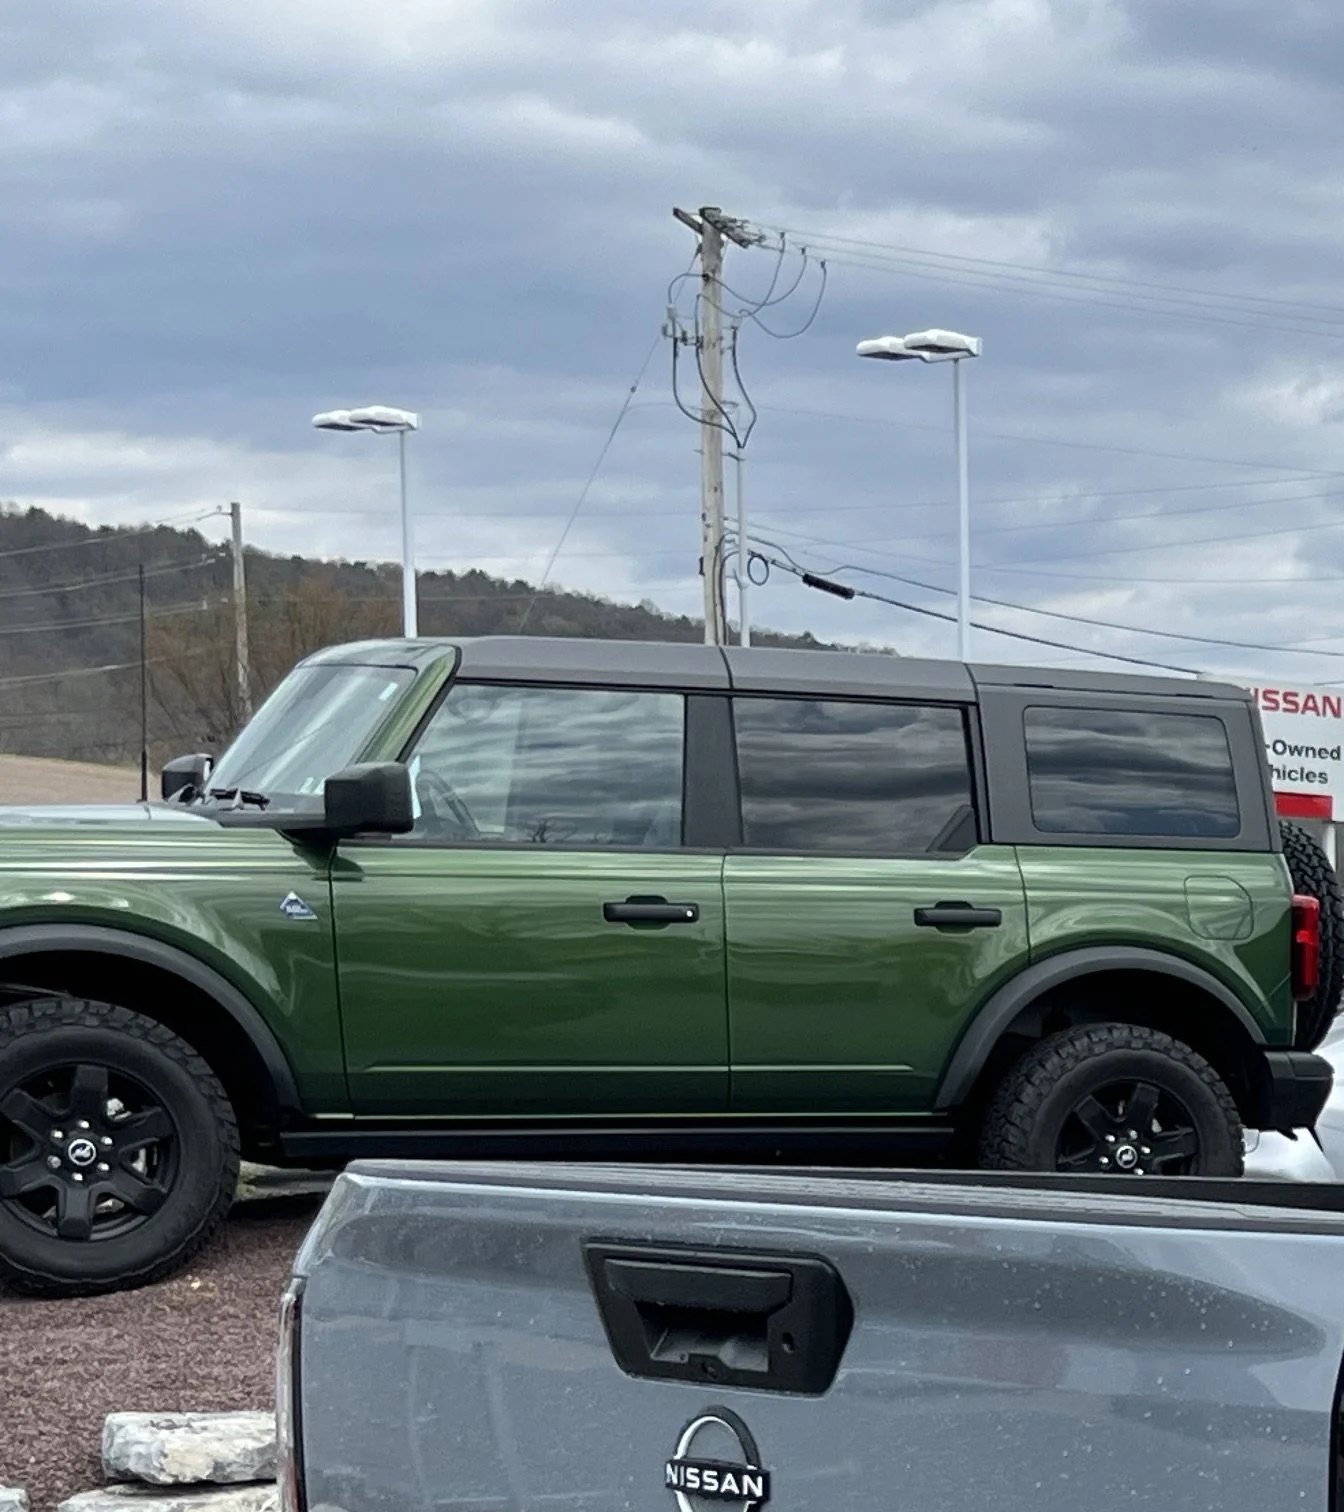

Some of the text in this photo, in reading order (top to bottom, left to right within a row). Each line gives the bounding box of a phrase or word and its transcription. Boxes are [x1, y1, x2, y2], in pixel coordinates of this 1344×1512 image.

[1253, 688, 1342, 719] ISSAN
[1265, 739, 1341, 761] -Owned
[1268, 764, 1329, 784] hicles
[666, 1463, 763, 1497] NISSAN
